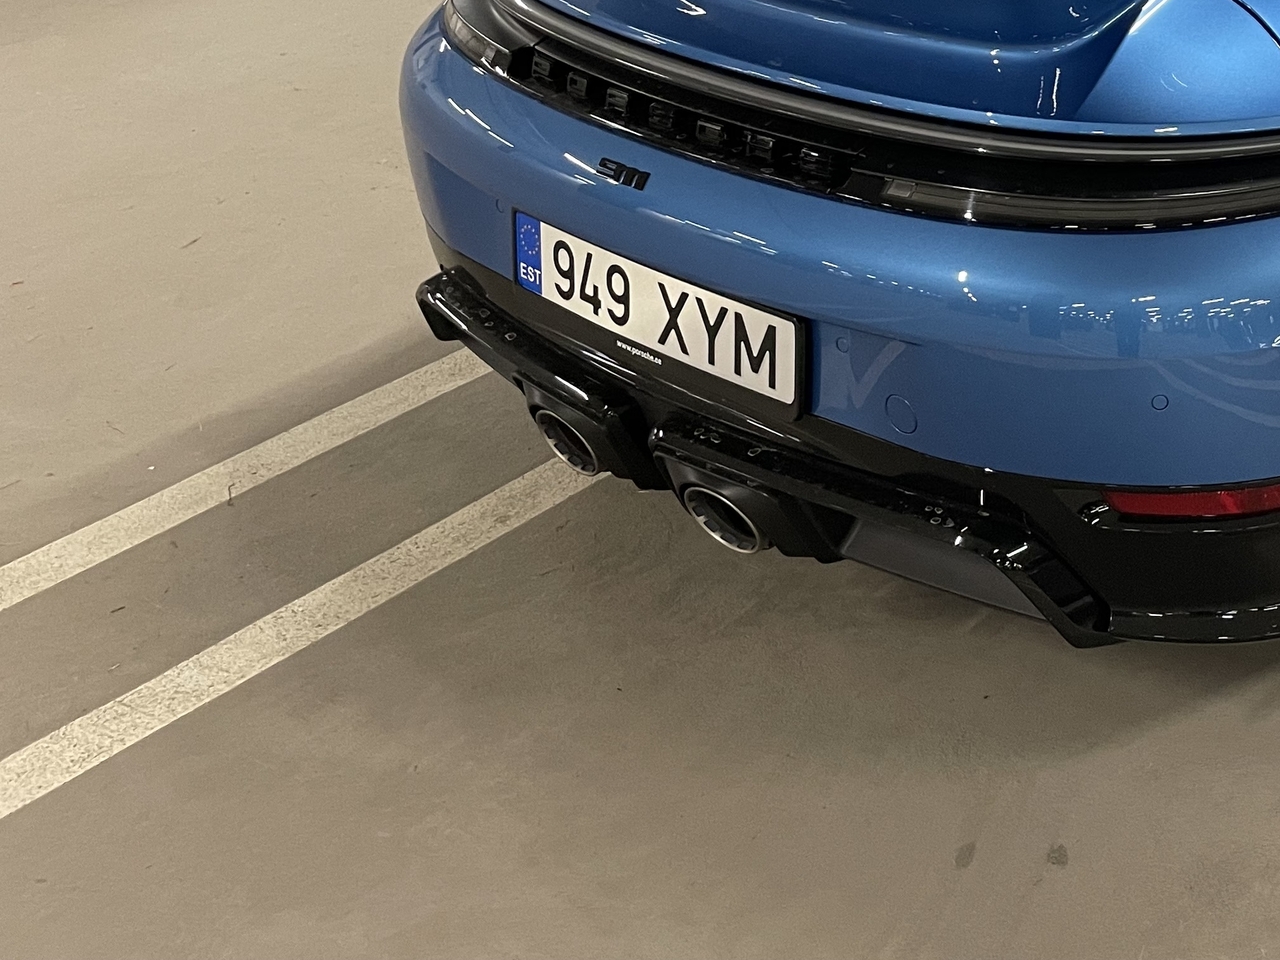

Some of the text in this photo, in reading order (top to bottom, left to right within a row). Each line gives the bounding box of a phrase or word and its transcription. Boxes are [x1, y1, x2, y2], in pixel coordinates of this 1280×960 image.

[520, 263, 541, 285] EST
[553, 240, 777, 390] 949 XYM
